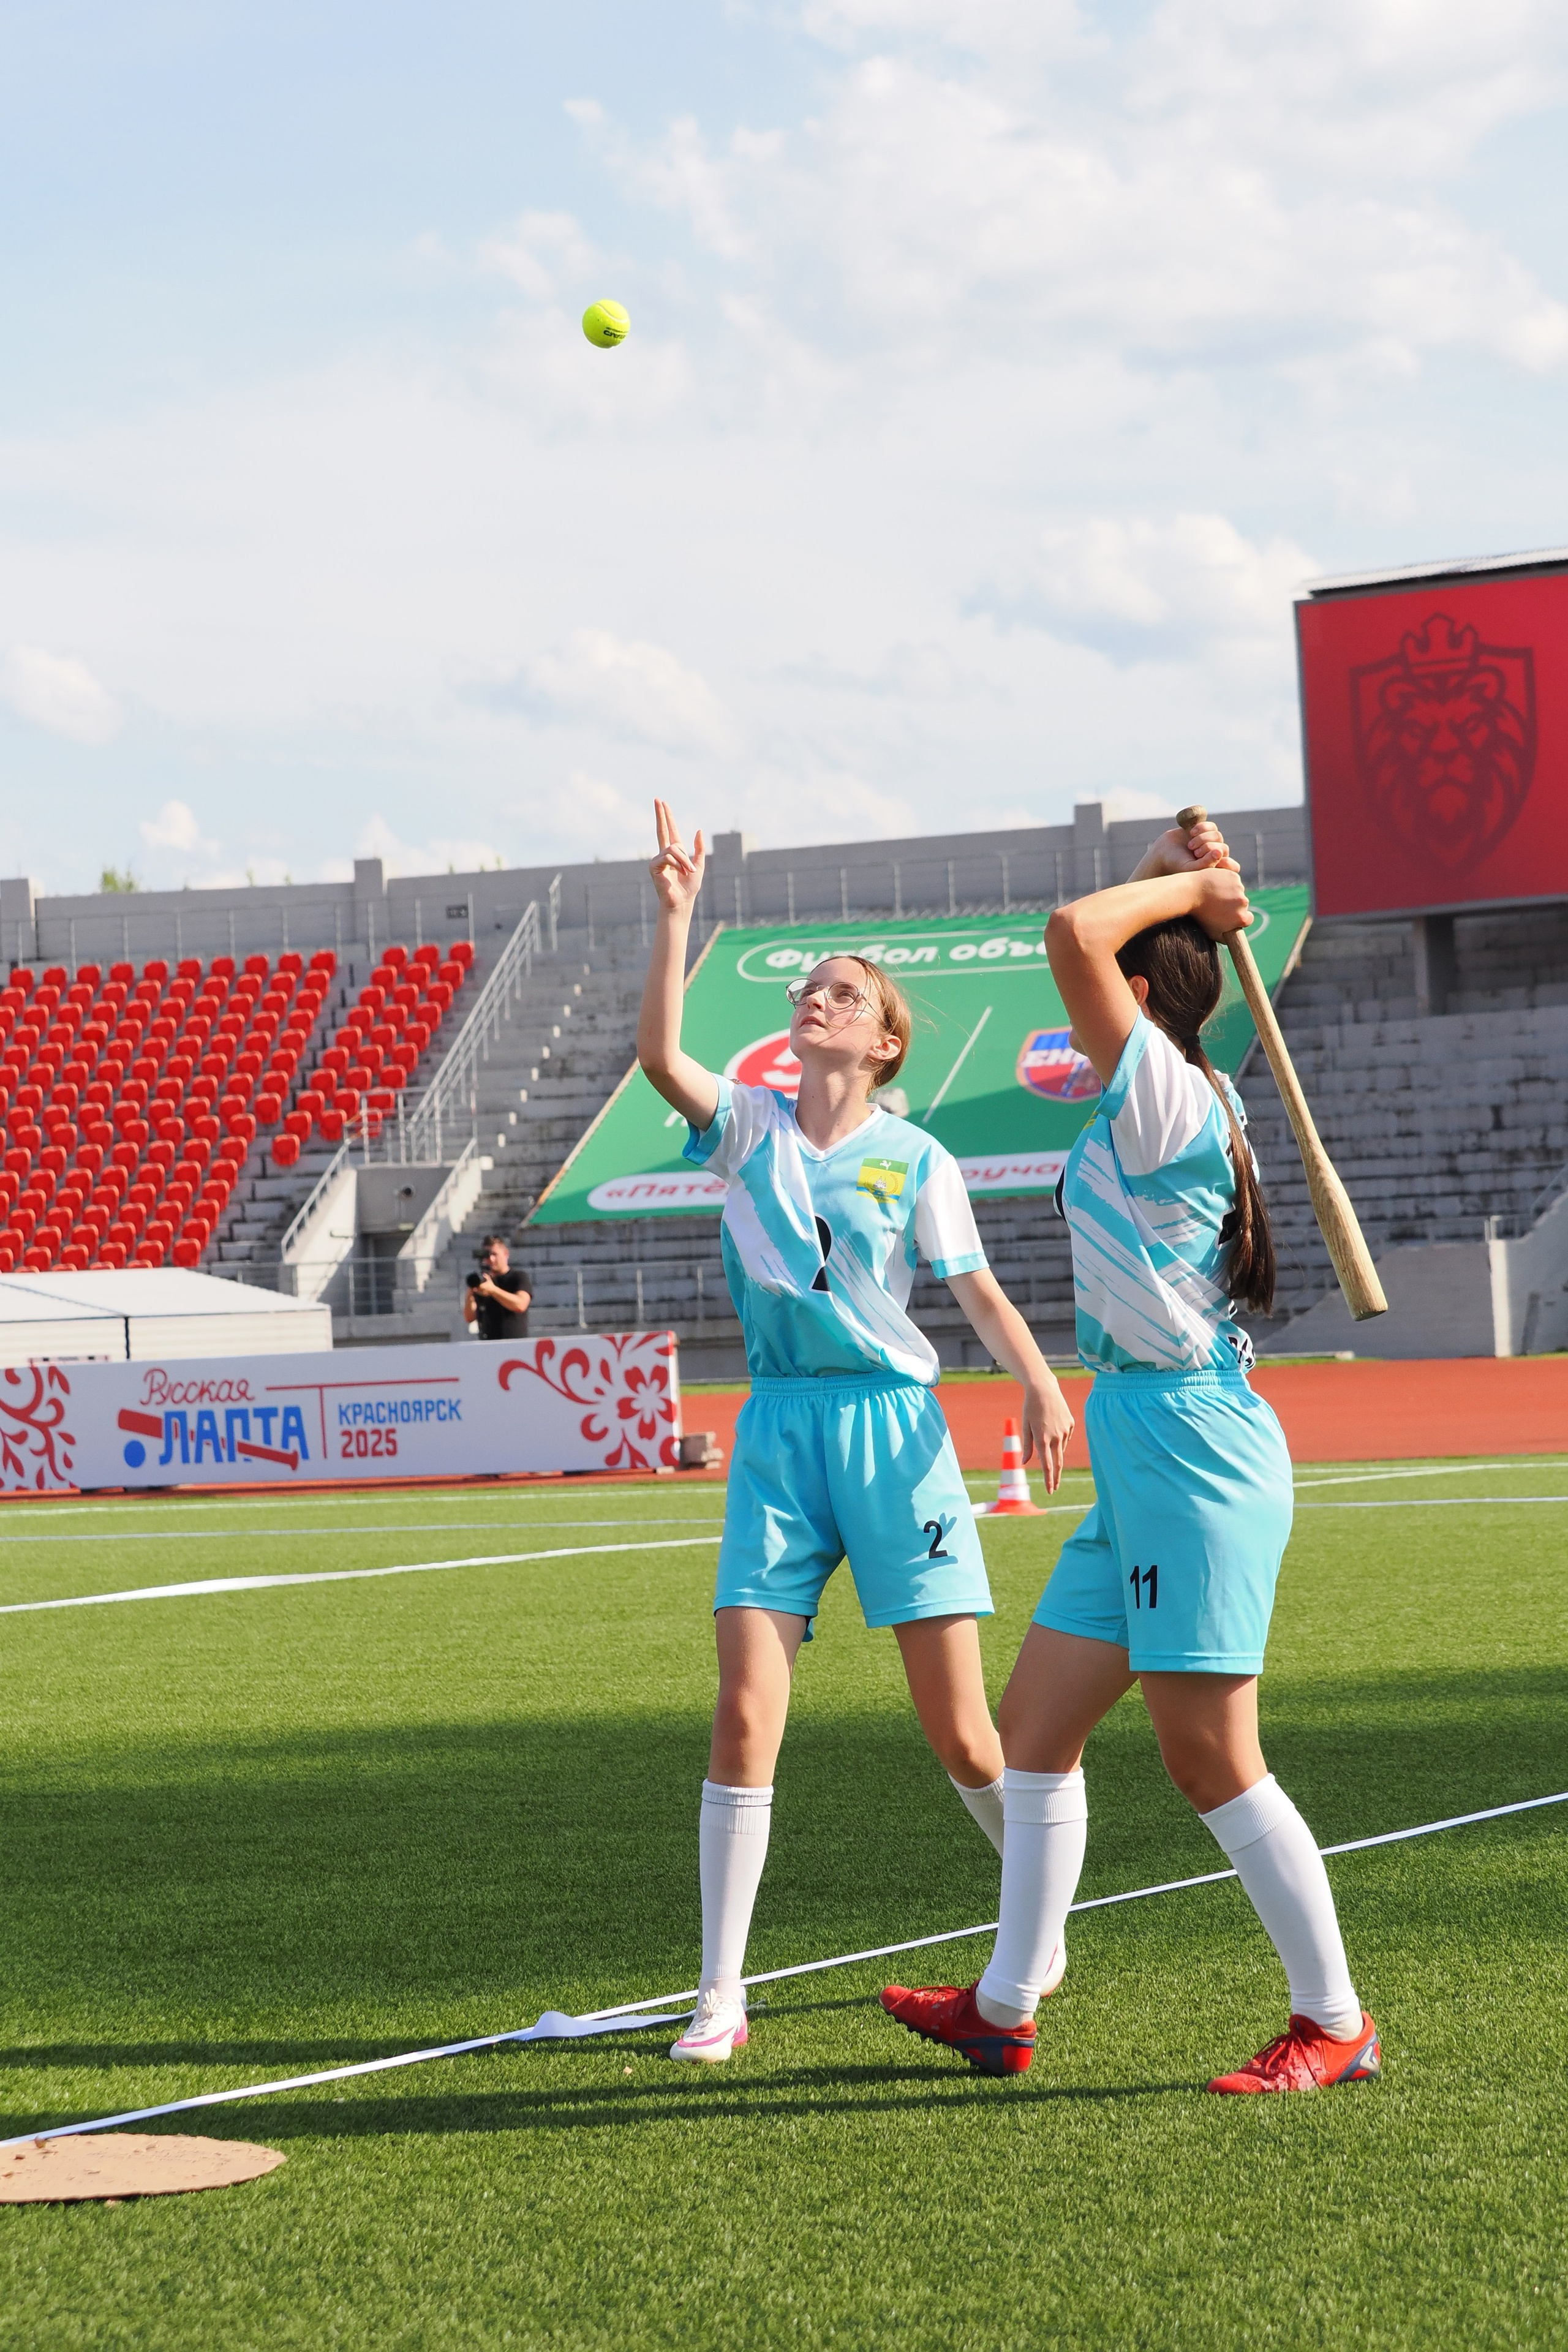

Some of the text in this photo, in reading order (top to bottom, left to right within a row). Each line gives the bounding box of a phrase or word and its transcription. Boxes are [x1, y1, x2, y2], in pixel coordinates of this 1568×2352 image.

[766, 943, 938, 973] Фубол
[606, 1178, 729, 1198] «Пятё
[140, 1368, 255, 1406] Русская
[338, 1398, 462, 1426] КРАСНОЯРСК
[159, 1405, 309, 1466] ЛАПТА
[341, 1427, 398, 1458] 2025
[923, 1520, 949, 1559] 2
[1129, 1564, 1158, 1610] 11
